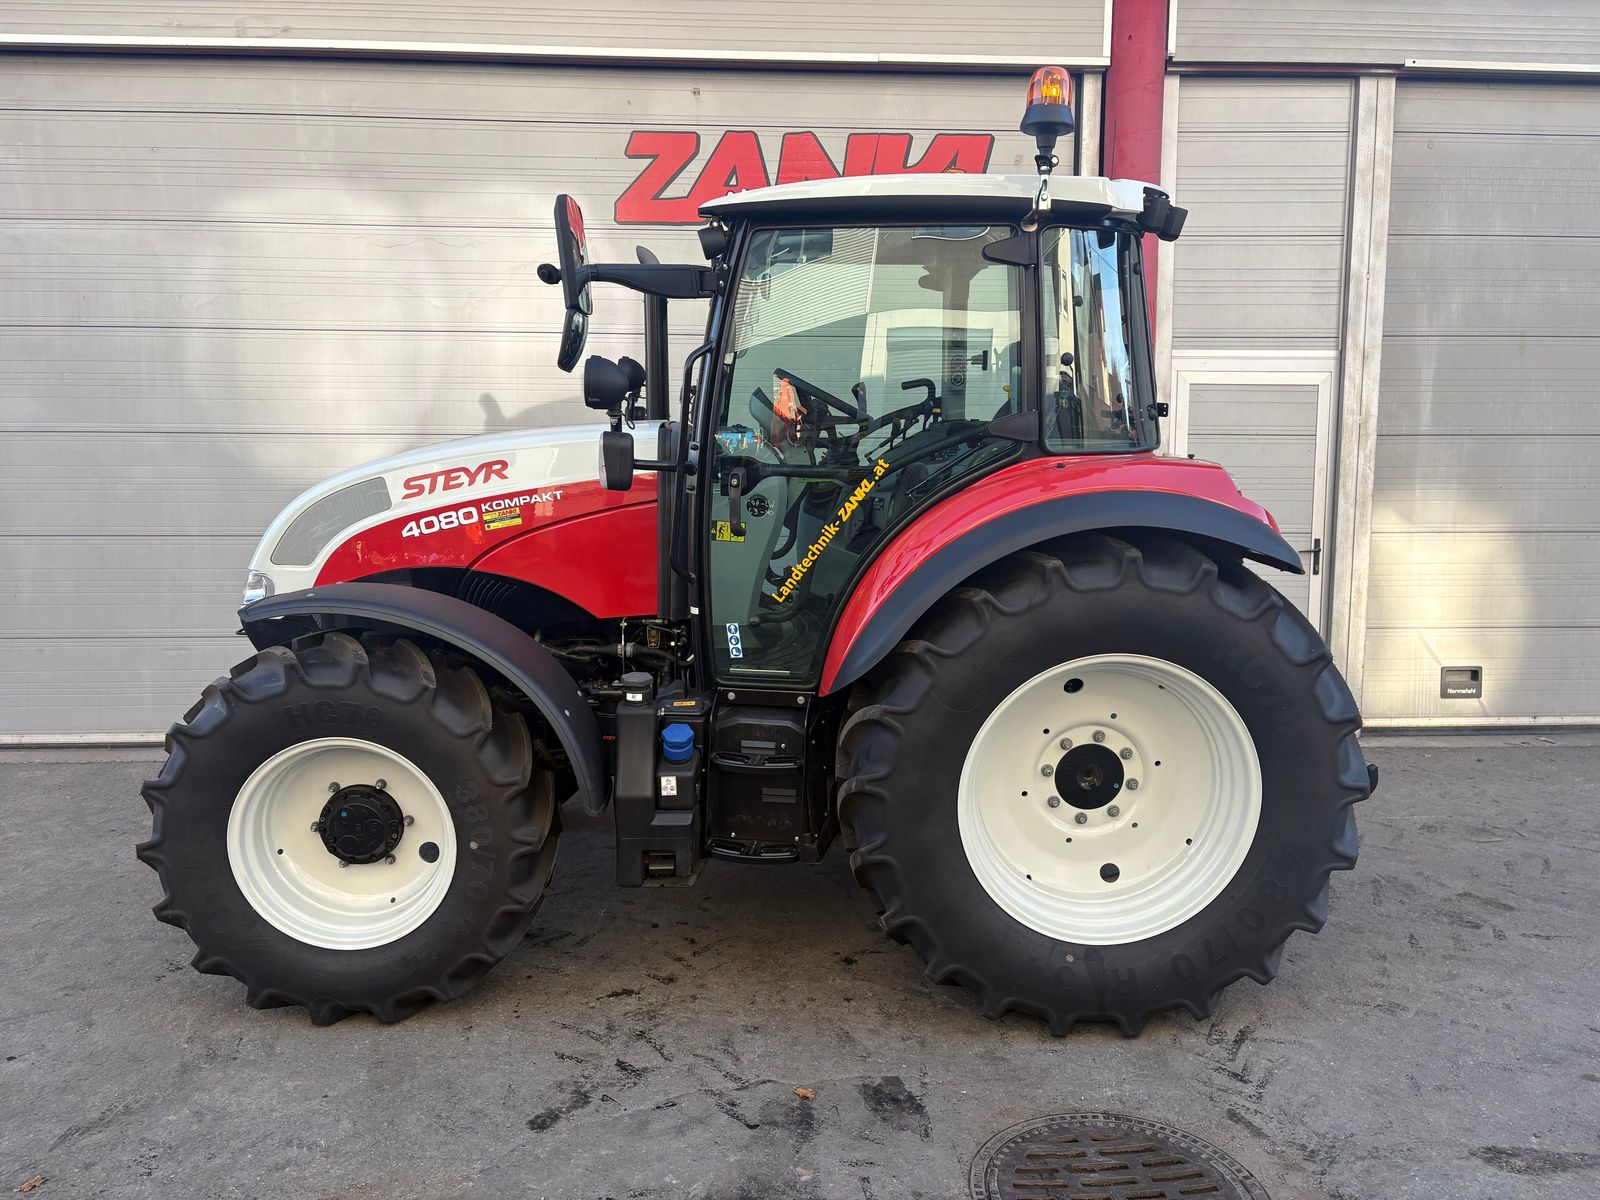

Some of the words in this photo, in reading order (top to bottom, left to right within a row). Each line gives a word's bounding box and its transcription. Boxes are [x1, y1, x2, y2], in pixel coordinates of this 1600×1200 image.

[402, 459, 509, 500] STEYR
[401, 506, 479, 538] 4080
[481, 490, 564, 513] KOMPAKT
